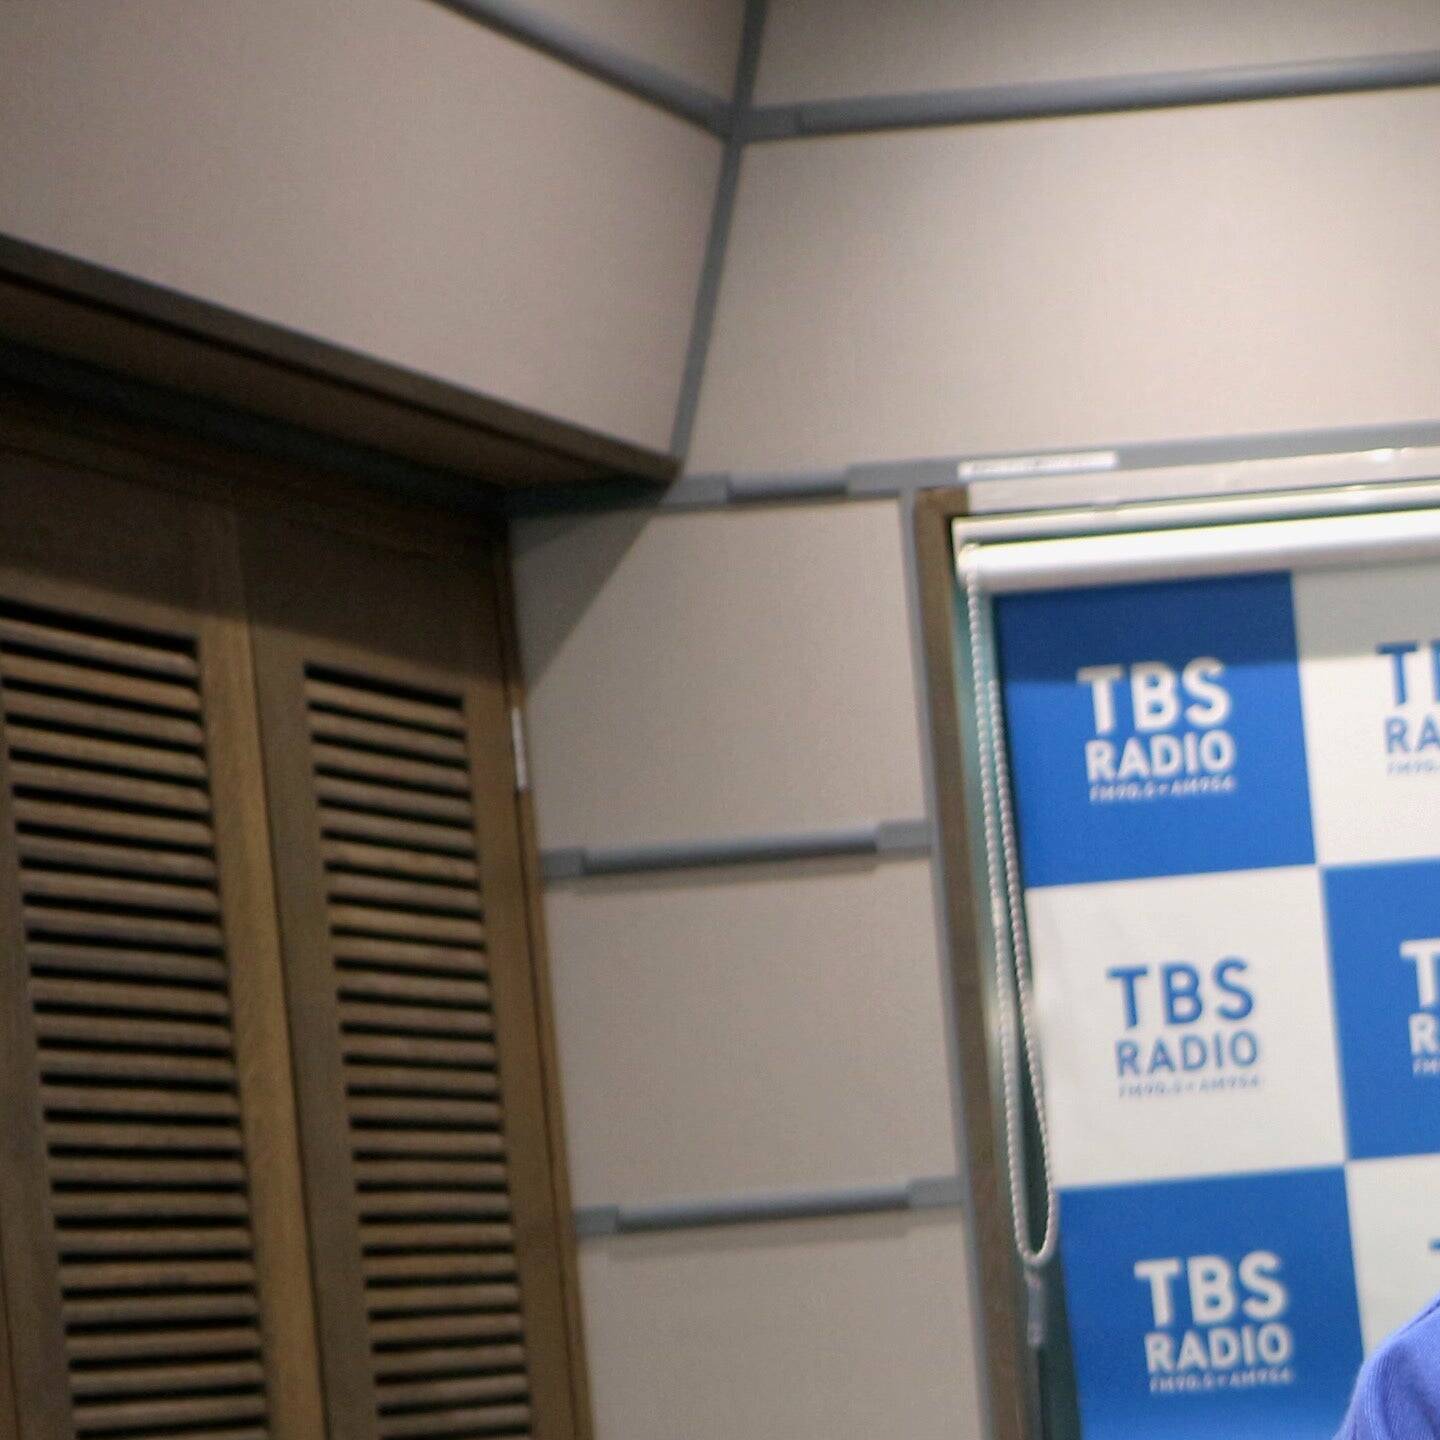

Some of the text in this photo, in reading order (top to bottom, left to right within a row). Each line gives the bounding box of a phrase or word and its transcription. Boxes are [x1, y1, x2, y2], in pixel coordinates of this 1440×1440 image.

[1077, 656, 1230, 734] TBS
[1085, 729, 1234, 781] RADIO
[1107, 956, 1255, 1029] TBS
[1116, 1030, 1258, 1077] RADIO
[1134, 1251, 1286, 1328] TBS
[1144, 1323, 1292, 1373] RADIO
